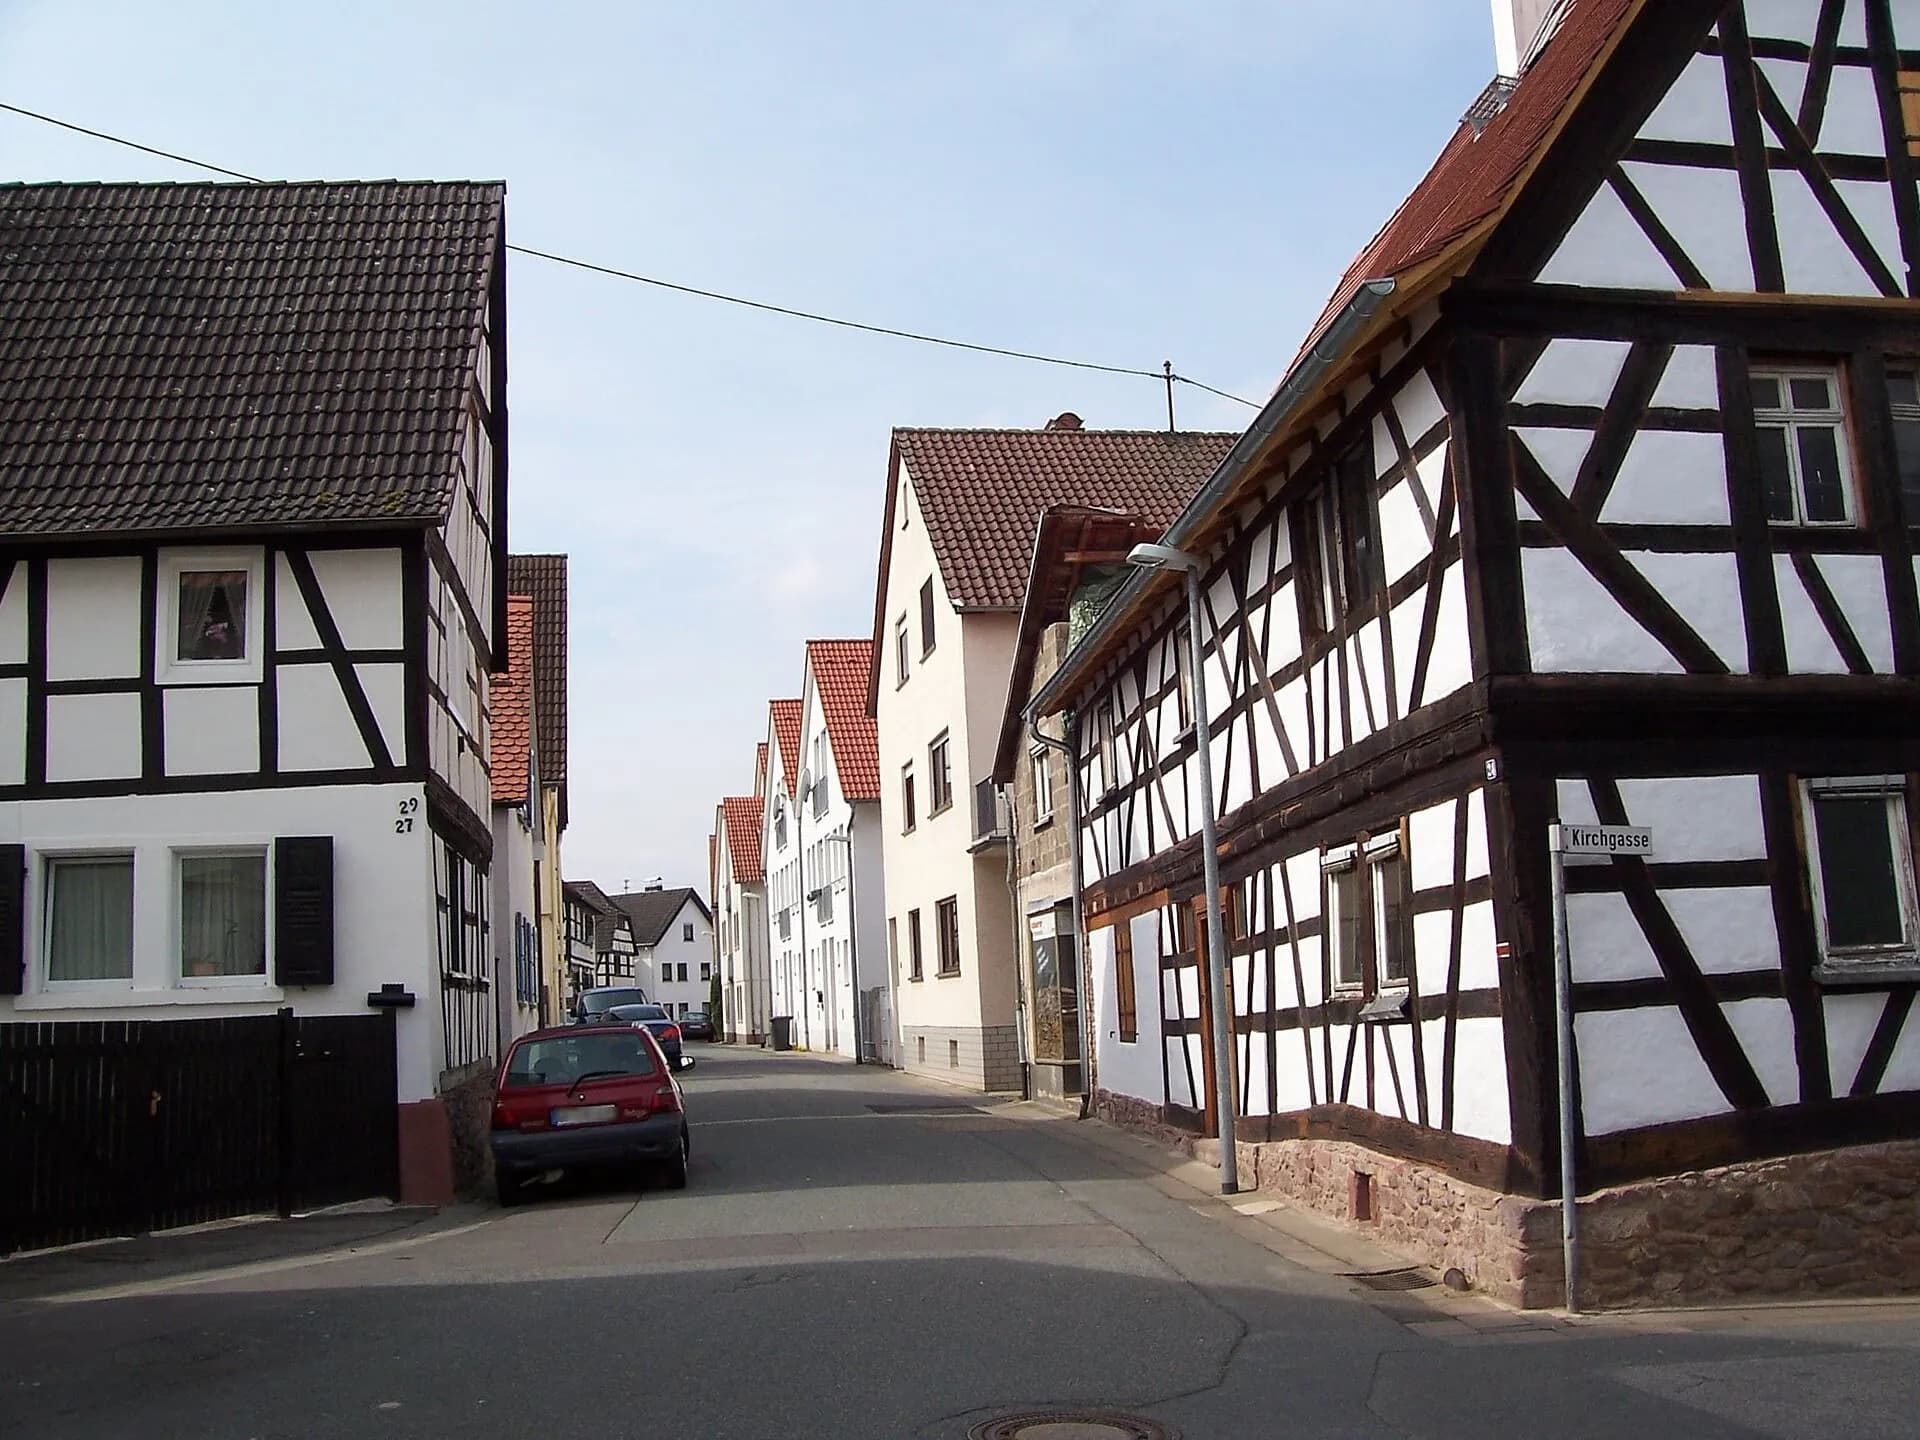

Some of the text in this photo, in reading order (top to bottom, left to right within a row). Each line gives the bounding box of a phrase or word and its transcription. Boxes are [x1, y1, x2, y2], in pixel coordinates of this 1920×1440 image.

[399, 797, 418, 814] 29
[395, 818, 413, 833] 27
[1572, 828, 1649, 851] Kirchgasse
